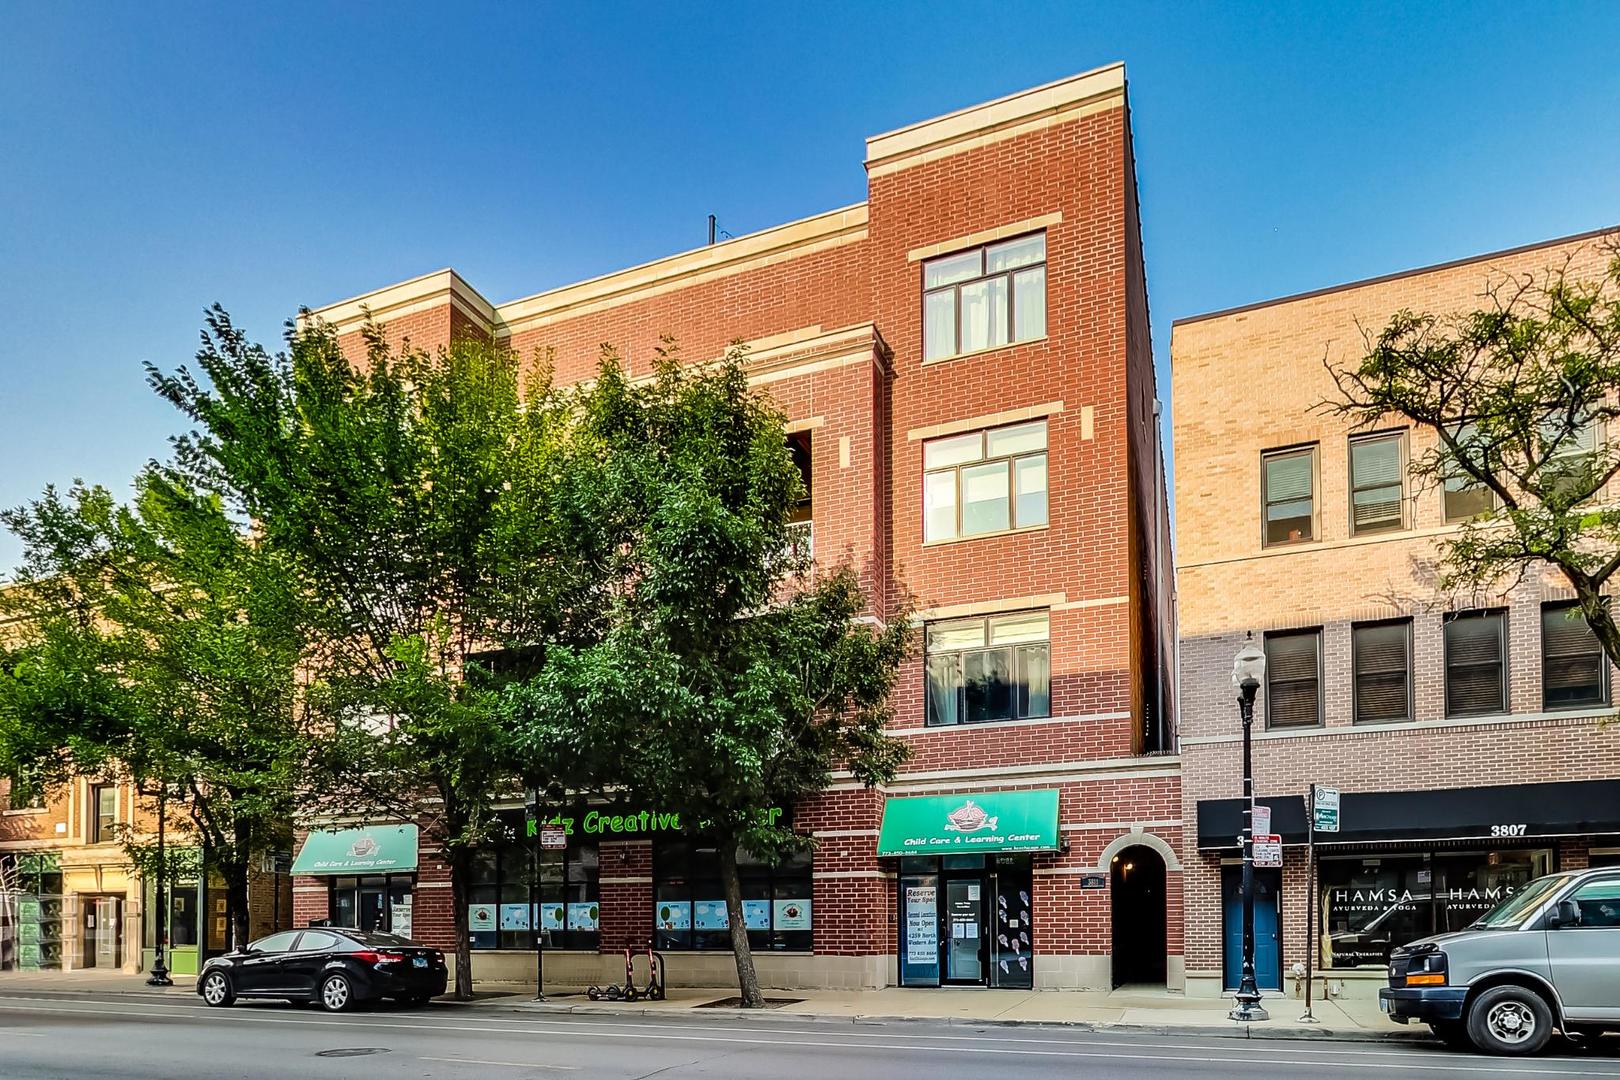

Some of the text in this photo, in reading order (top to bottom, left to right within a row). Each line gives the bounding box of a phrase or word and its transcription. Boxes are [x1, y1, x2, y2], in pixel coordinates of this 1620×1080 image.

[584, 810, 682, 834] Creative
[1491, 824, 1527, 837] 3807
[903, 833, 1041, 846] Child Care & Learning Center
[908, 889, 935, 897] Reserve
[1336, 888, 1414, 902] HAMSA
[1450, 886, 1515, 900] HAMS
